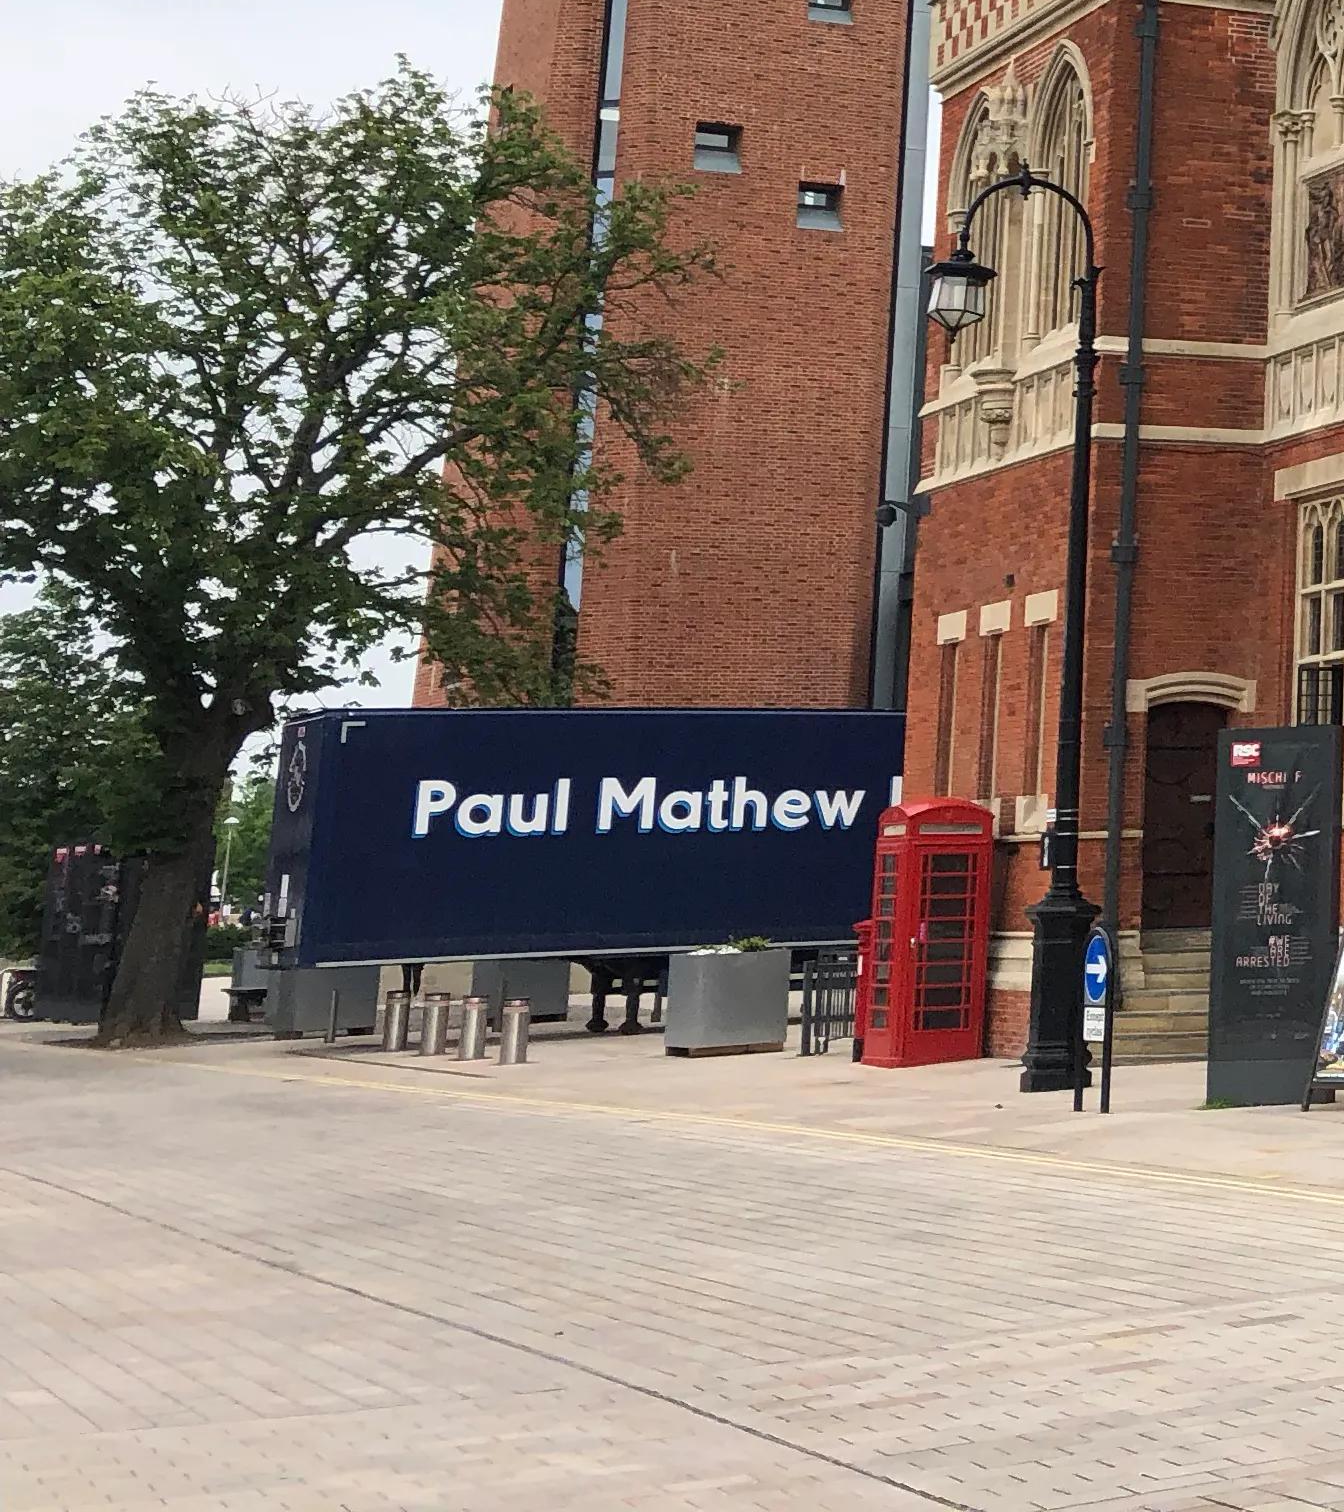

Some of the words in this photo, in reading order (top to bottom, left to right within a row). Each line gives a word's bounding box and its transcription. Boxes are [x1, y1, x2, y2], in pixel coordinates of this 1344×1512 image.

[1247, 771, 1302, 784] MISCHIF
[412, 778, 570, 838] Paul
[597, 776, 866, 834] Mathew
[1259, 904, 1278, 914] THE
[1257, 914, 1292, 925] LIVING
[1236, 956, 1290, 967] ARRESTED
